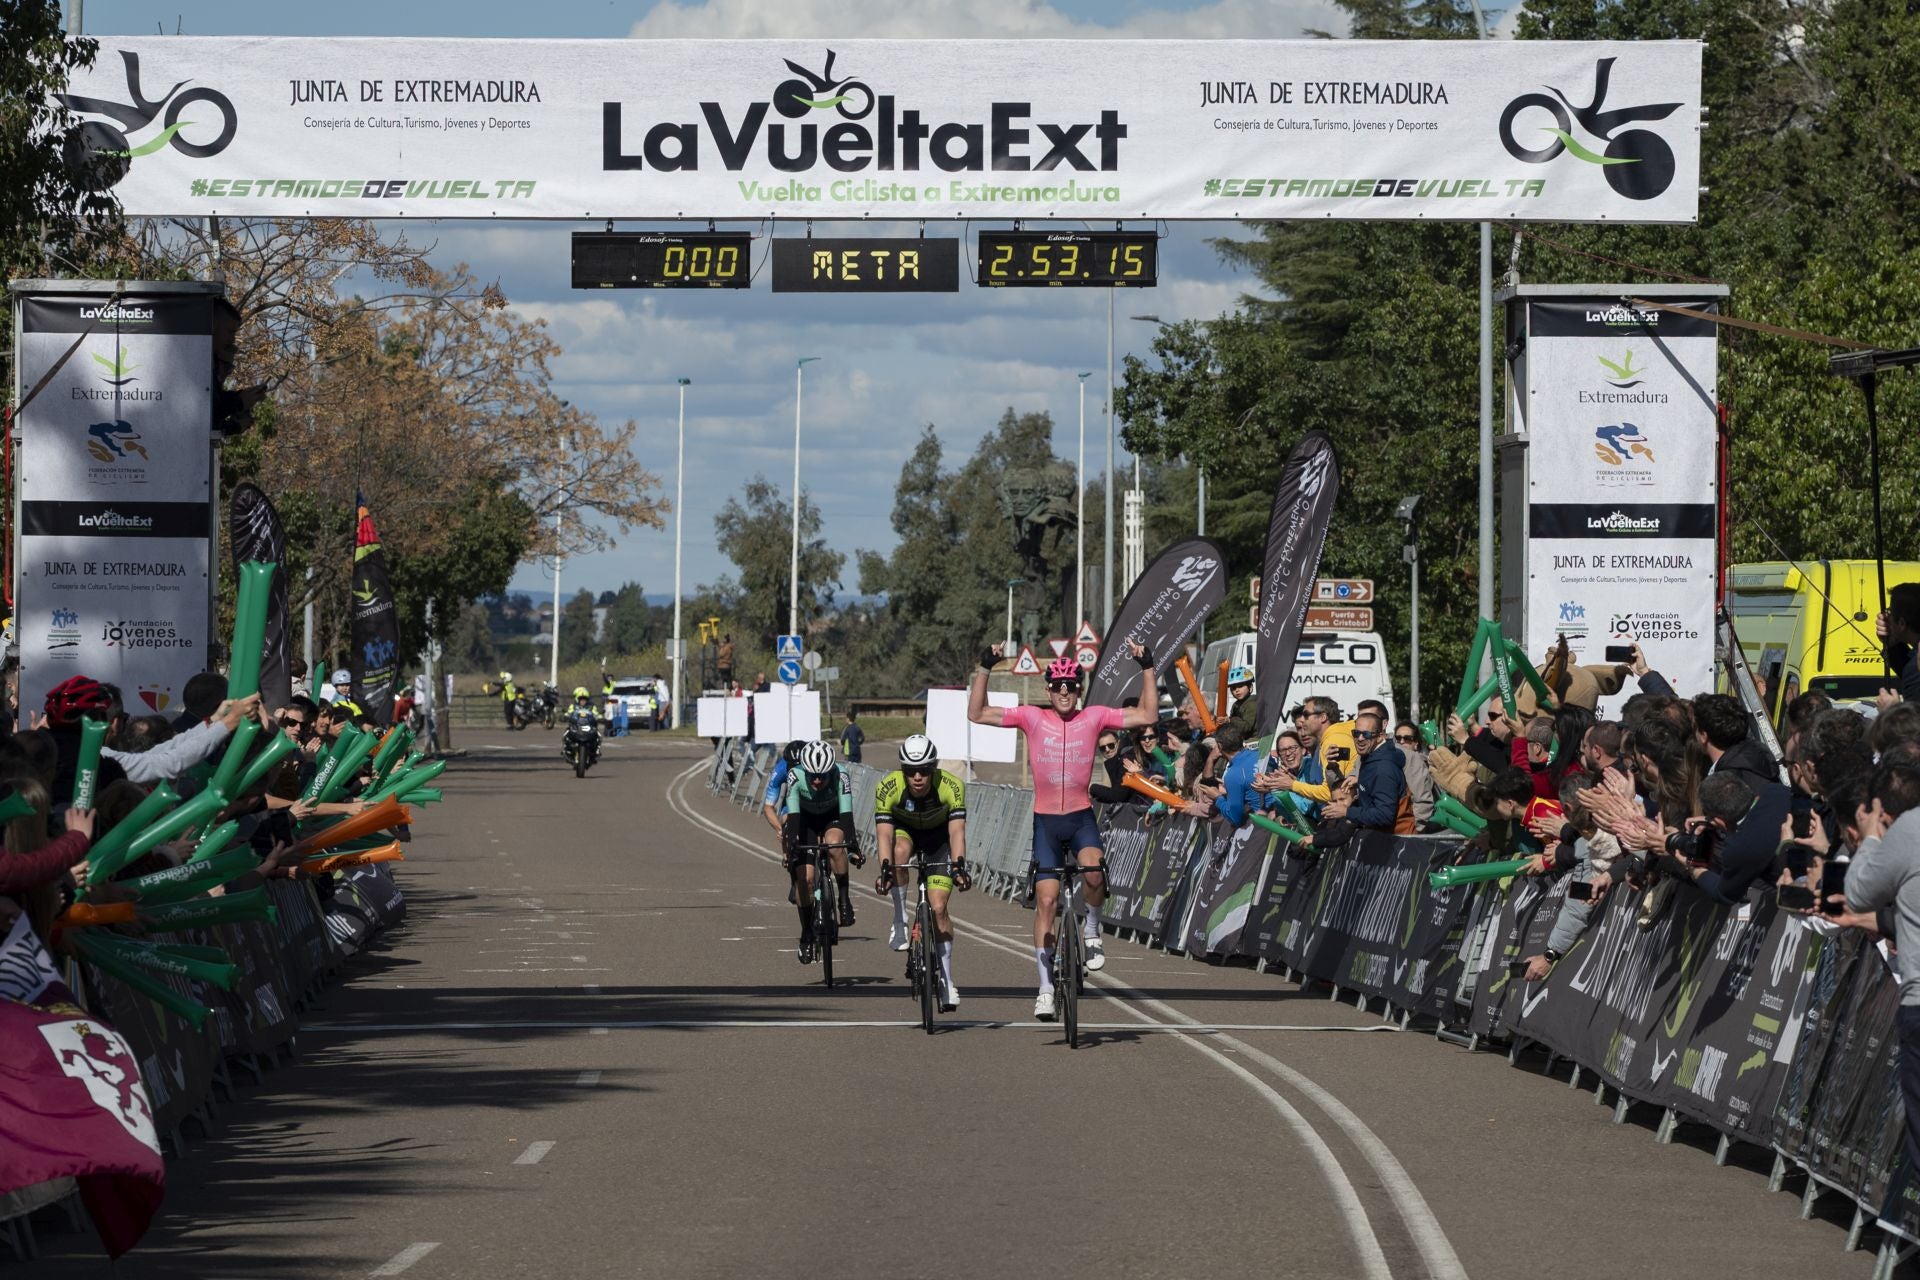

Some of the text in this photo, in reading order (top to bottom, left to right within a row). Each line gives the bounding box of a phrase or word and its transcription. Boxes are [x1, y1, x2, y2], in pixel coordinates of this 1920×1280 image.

[289, 80, 542, 106] JUNTA DE EXTREMADURA
[1200, 81, 1449, 107] JUNTA DE EXTREMADURA
[303, 116, 351, 131] Consejería
[354, 117, 365, 128] de
[443, 116, 478, 131] Jóvenes
[481, 121, 487, 131] y
[489, 117, 531, 131] Deportes
[1213, 118, 1260, 133] Consejería
[1263, 119, 1274, 130] de
[1352, 118, 1386, 133] Jóvenes
[1389, 123, 1395, 133] y
[1397, 119, 1438, 133] Deportes
[602, 95, 1128, 172] LaVueltaExt
[738, 179, 1121, 203] Vuelta Ciclista a Extremadura
[813, 250, 919, 280] META
[80, 307, 154, 319] LaVueltaExt
[71, 386, 163, 401] Extremadura
[1579, 390, 1668, 404] Extremadura
[79, 515, 153, 527] LaVueltaExt
[1587, 517, 1660, 529] LaVueltaExt
[44, 562, 186, 577] JUNTA DE EXTREMADURA
[1553, 555, 1693, 570] JUNTA DE EXTREMADURA
[129, 619, 173, 627] fundación
[1635, 612, 1679, 620] fundación
[1124, 592, 1181, 660] CCLISMO
[128, 637, 192, 650] ydeporte
[1635, 630, 1698, 642] ydeporte
[1079, 654, 1094, 662] 20
[1246, 644, 1377, 665] IECO
[1495, 656, 1511, 704] LaVueltaExt
[139, 859, 212, 888] LaVueltaExt
[115, 948, 189, 974] LaVueltaExt
